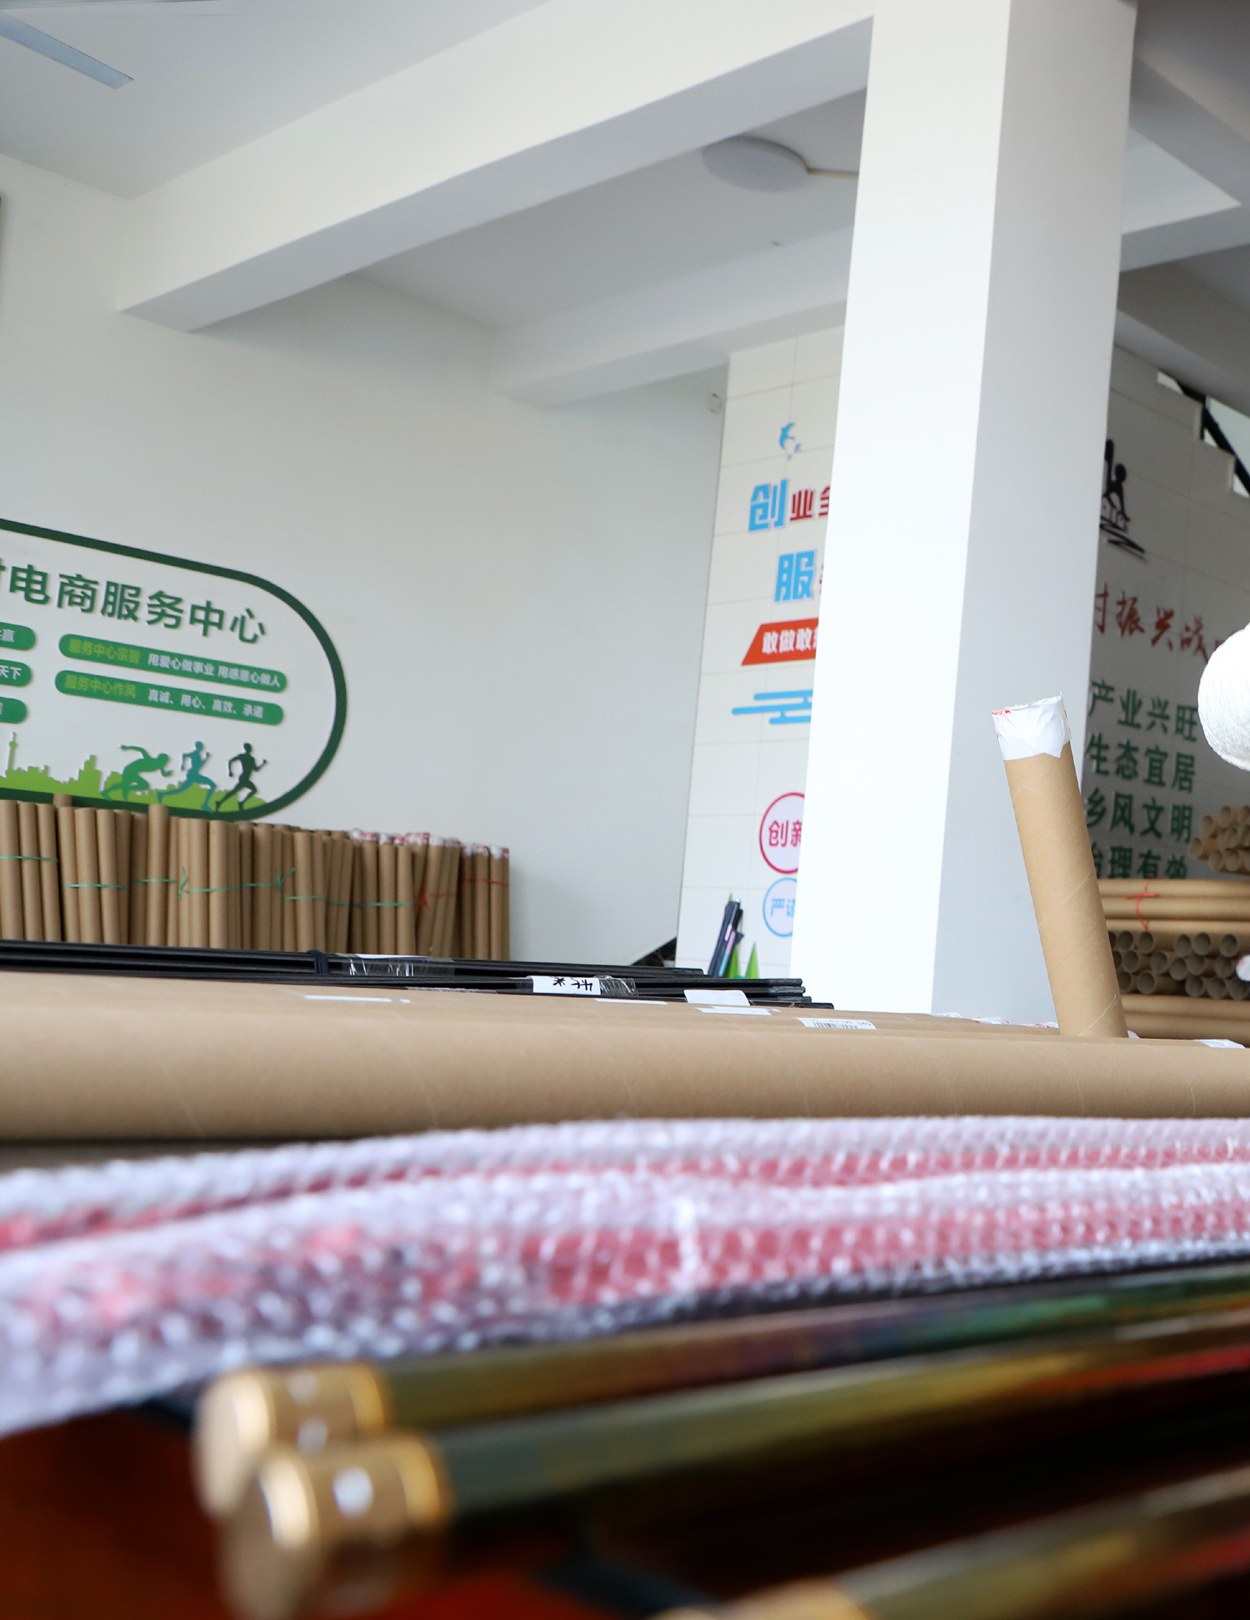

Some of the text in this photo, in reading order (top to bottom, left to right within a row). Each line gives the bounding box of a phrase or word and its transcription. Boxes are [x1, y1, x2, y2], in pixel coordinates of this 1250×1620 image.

[0, 558, 266, 644] 电商服务中心
[774, 550, 823, 602] 服
[762, 626, 817, 655] 敢做敢
[1088, 680, 1198, 743] 产业兴旺
[1084, 733, 1196, 793] 生态宜居
[1086, 788, 1193, 843] 乡风文明
